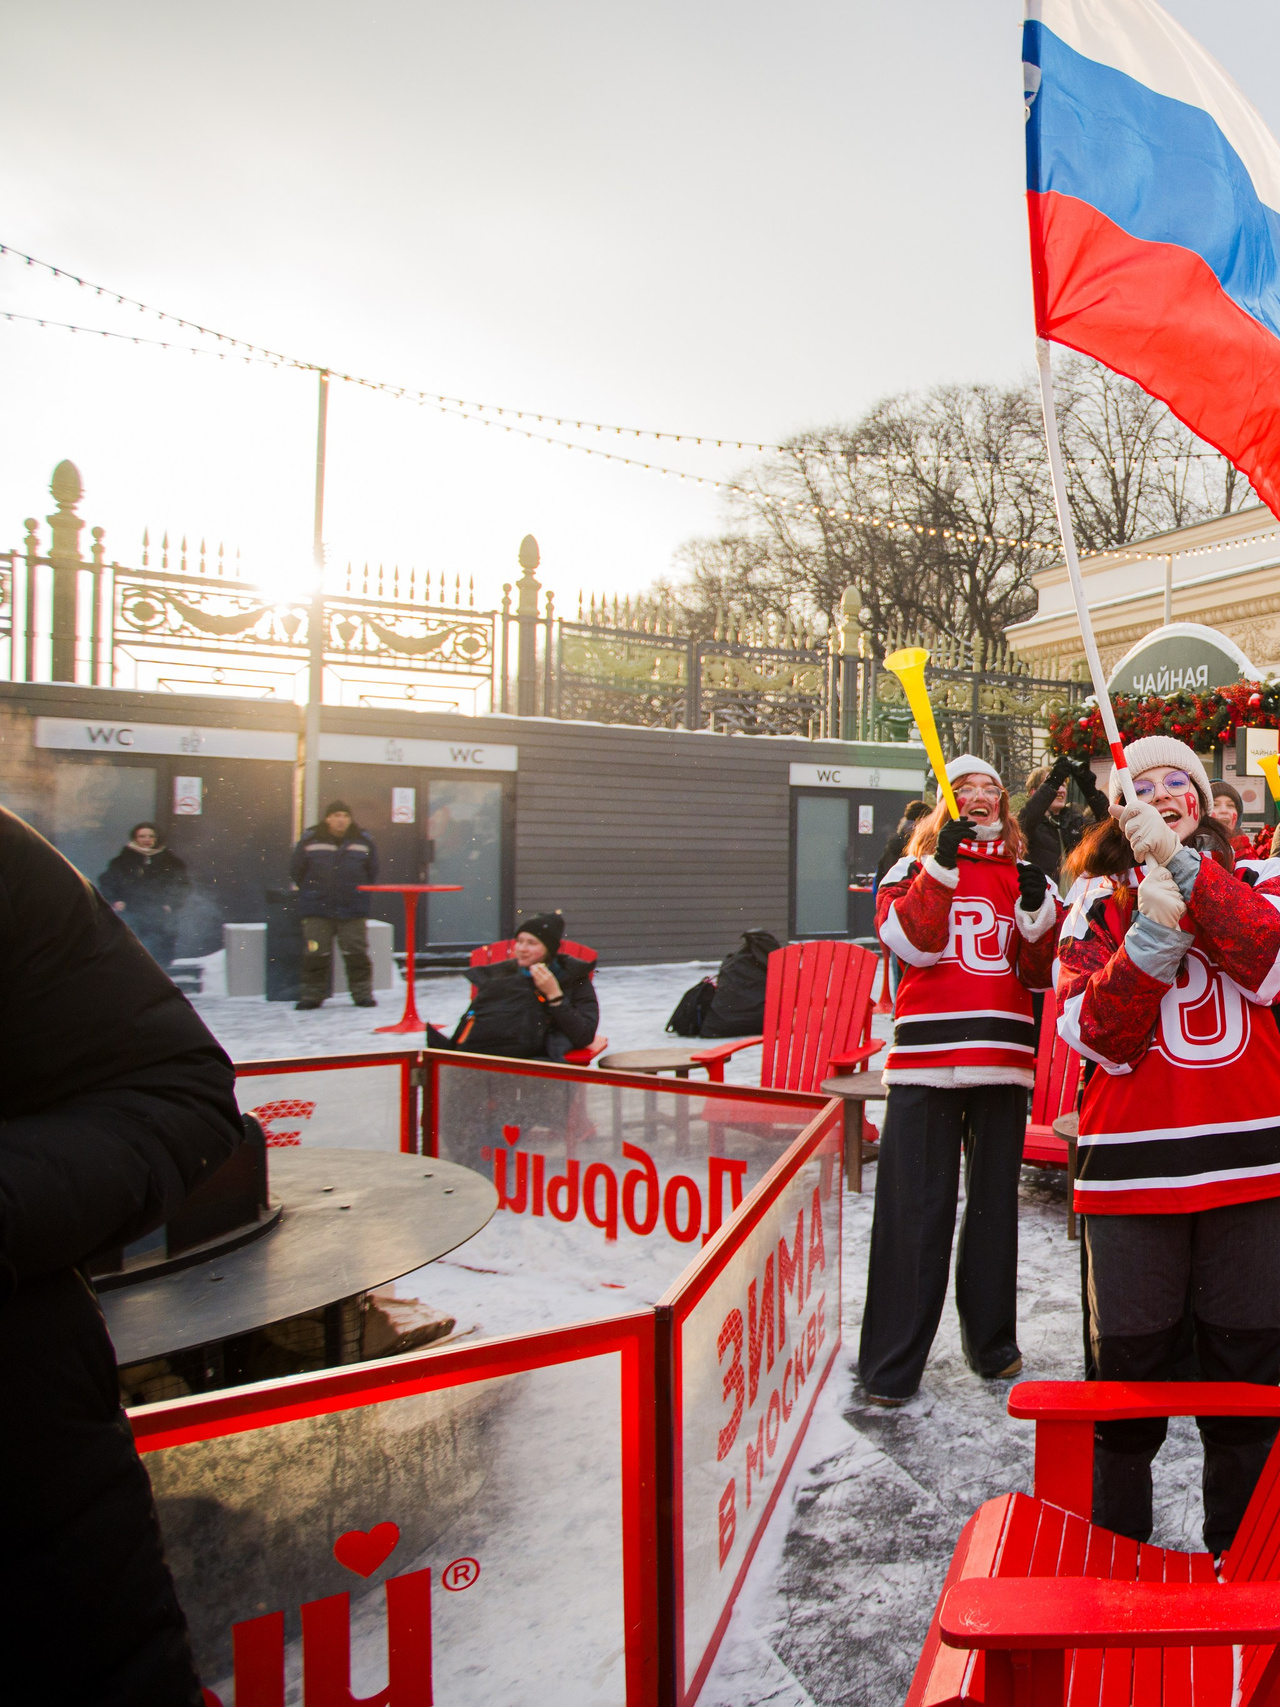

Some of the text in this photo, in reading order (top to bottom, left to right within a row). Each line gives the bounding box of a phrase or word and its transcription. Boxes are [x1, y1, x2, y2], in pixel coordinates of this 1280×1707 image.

[1132, 664, 1209, 694] ЧАЙНАЯ
[86, 726, 134, 746] WC
[449, 747, 486, 765] WC
[816, 769, 841, 783] WC
[717, 1185, 826, 1462] ЗИМА
[718, 1290, 826, 1571] В МОСКВЕ
